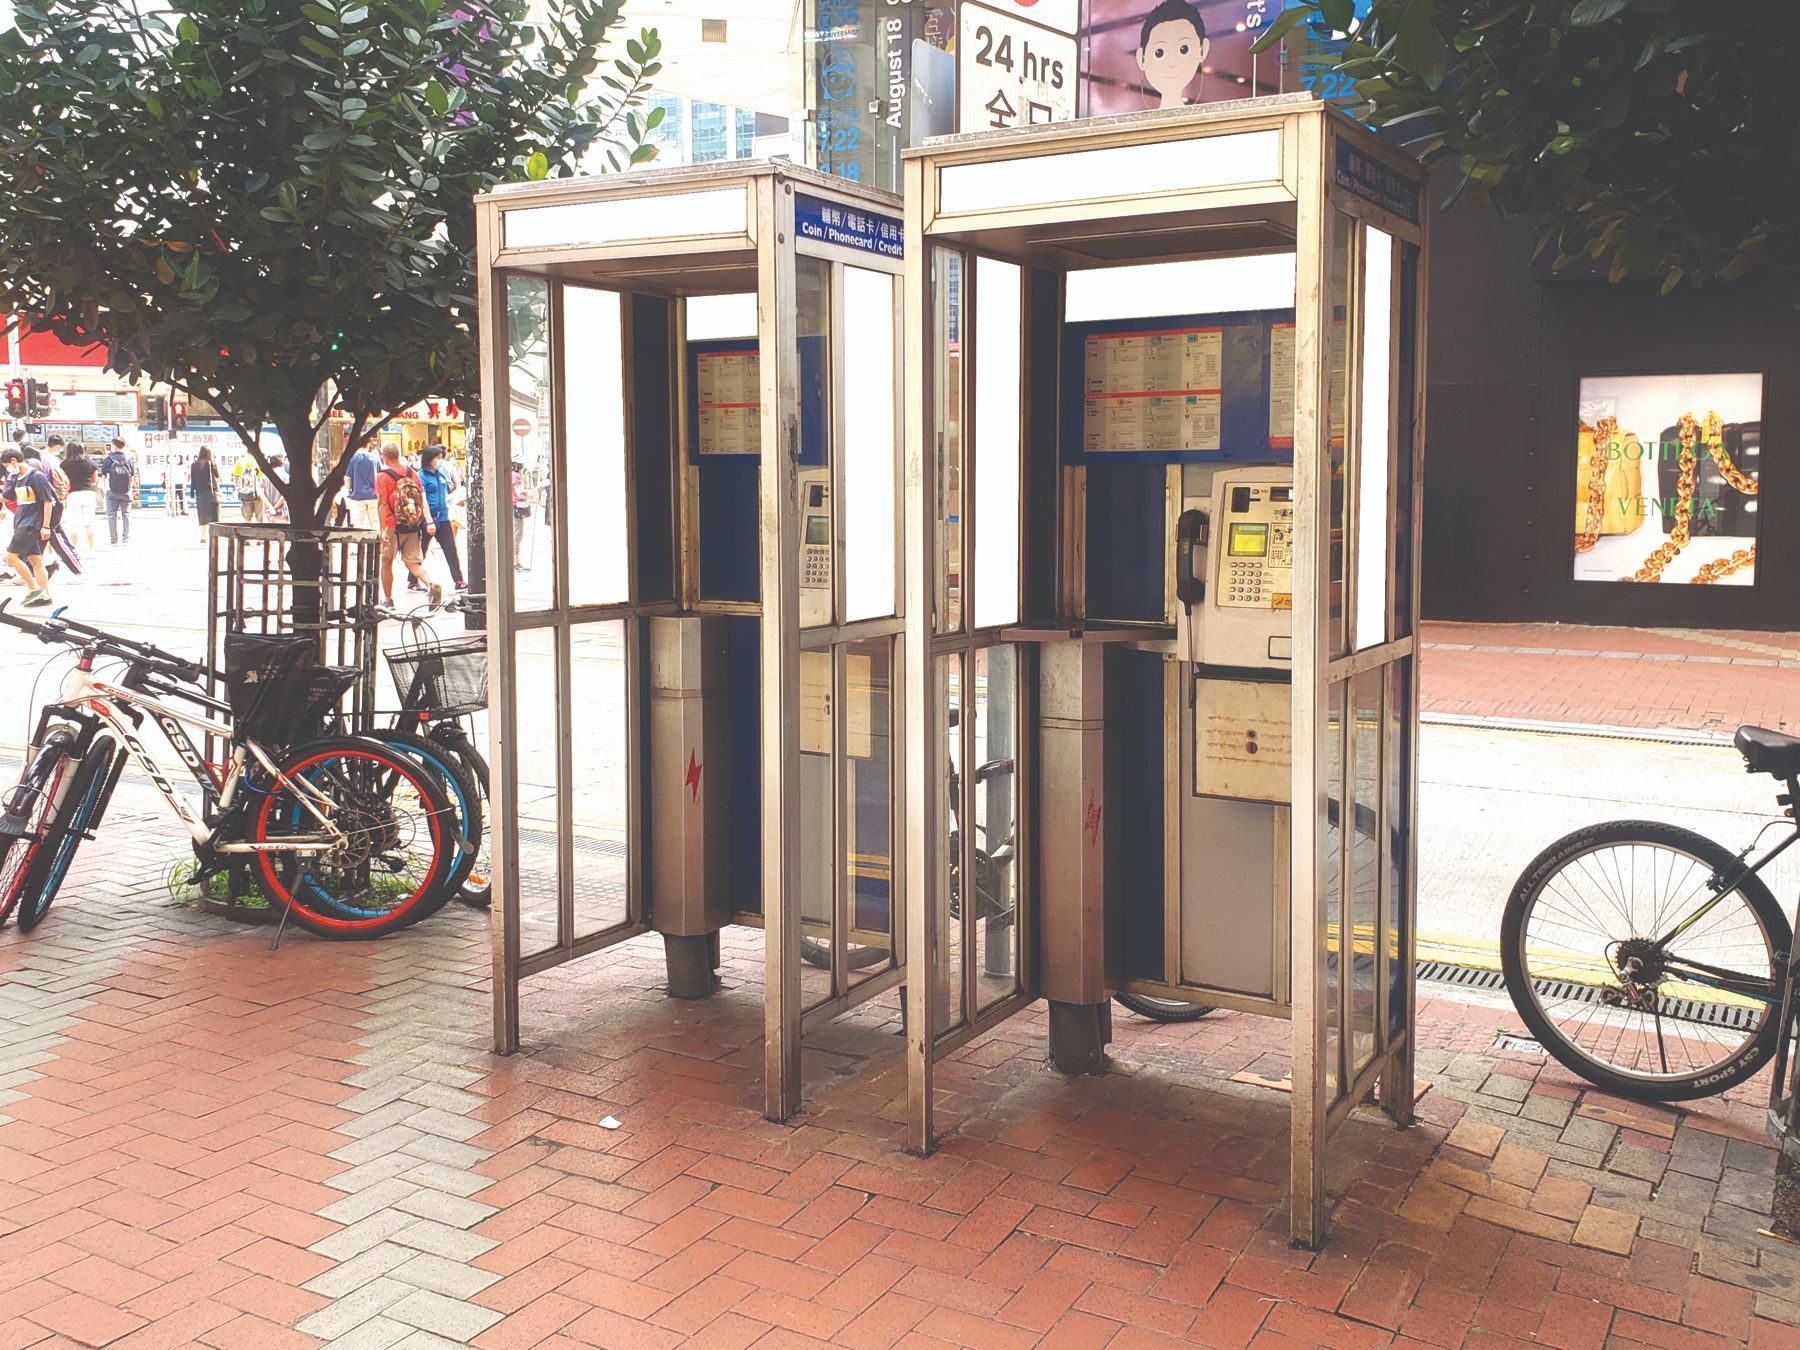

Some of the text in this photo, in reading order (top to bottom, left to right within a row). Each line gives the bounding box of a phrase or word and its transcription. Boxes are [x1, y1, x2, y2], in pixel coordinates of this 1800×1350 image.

[886, 18, 903, 44] 18
[975, 25, 1064, 89] 24 hrs
[886, 49, 906, 129] August
[802, 222, 822, 238] Coin
[828, 228, 873, 249] Phonecard
[878, 240, 903, 256] Credit
[124, 734, 173, 794] GSD
[161, 717, 200, 768] GSD
[1692, 1065, 1737, 1088] SPORT
